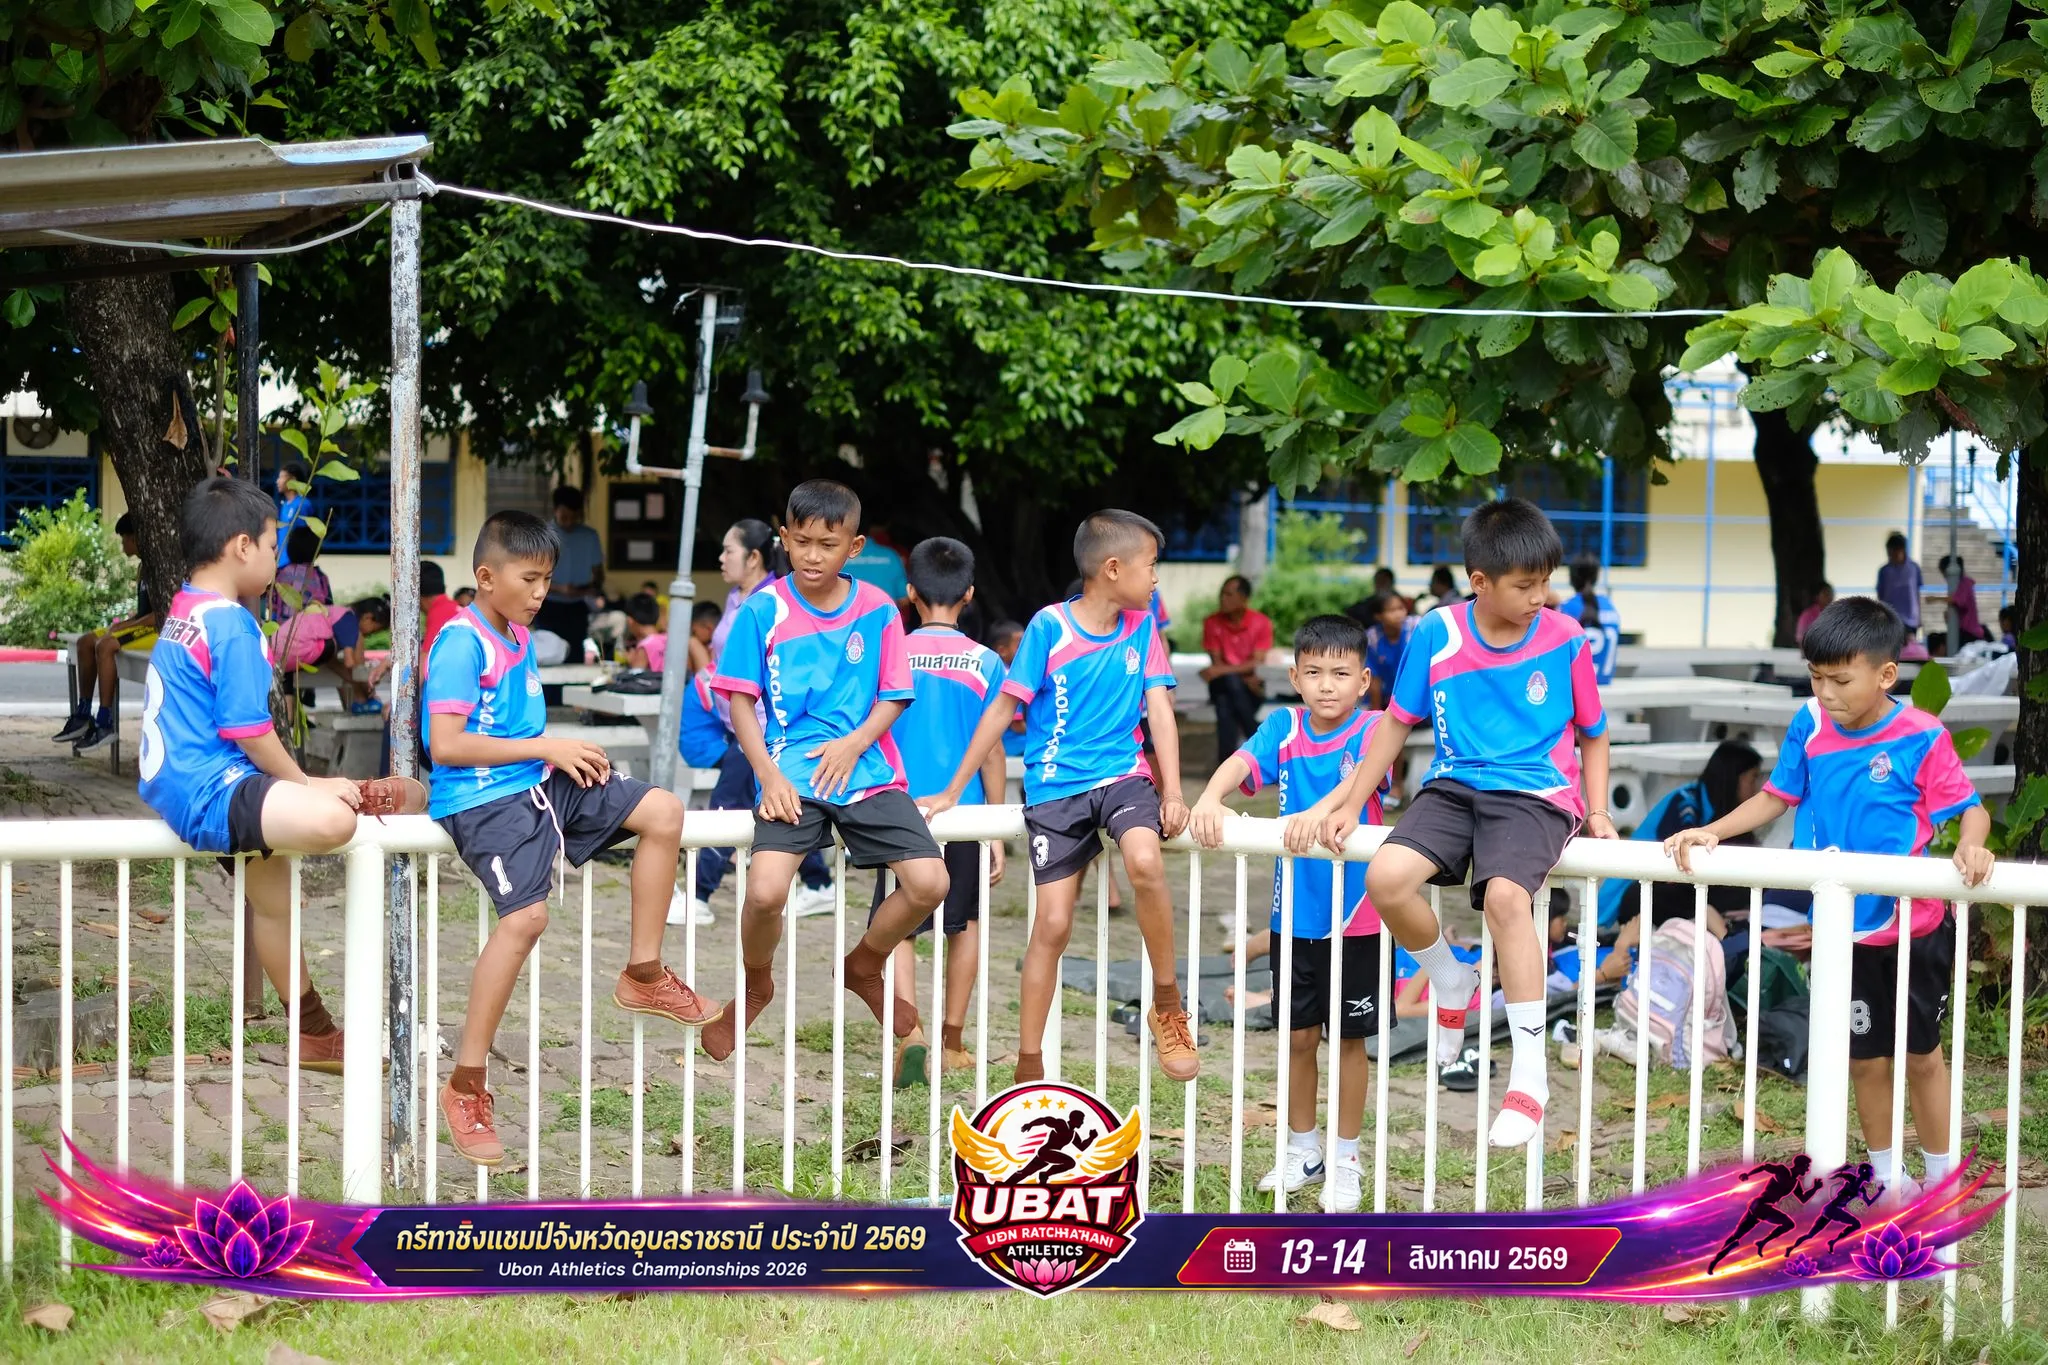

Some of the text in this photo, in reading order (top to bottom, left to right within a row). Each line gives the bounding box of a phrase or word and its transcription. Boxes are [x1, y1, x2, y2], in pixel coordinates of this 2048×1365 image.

[1032, 834, 1050, 867] 3
[490, 855, 513, 896] 1
[1850, 1000, 1871, 1035] 8
